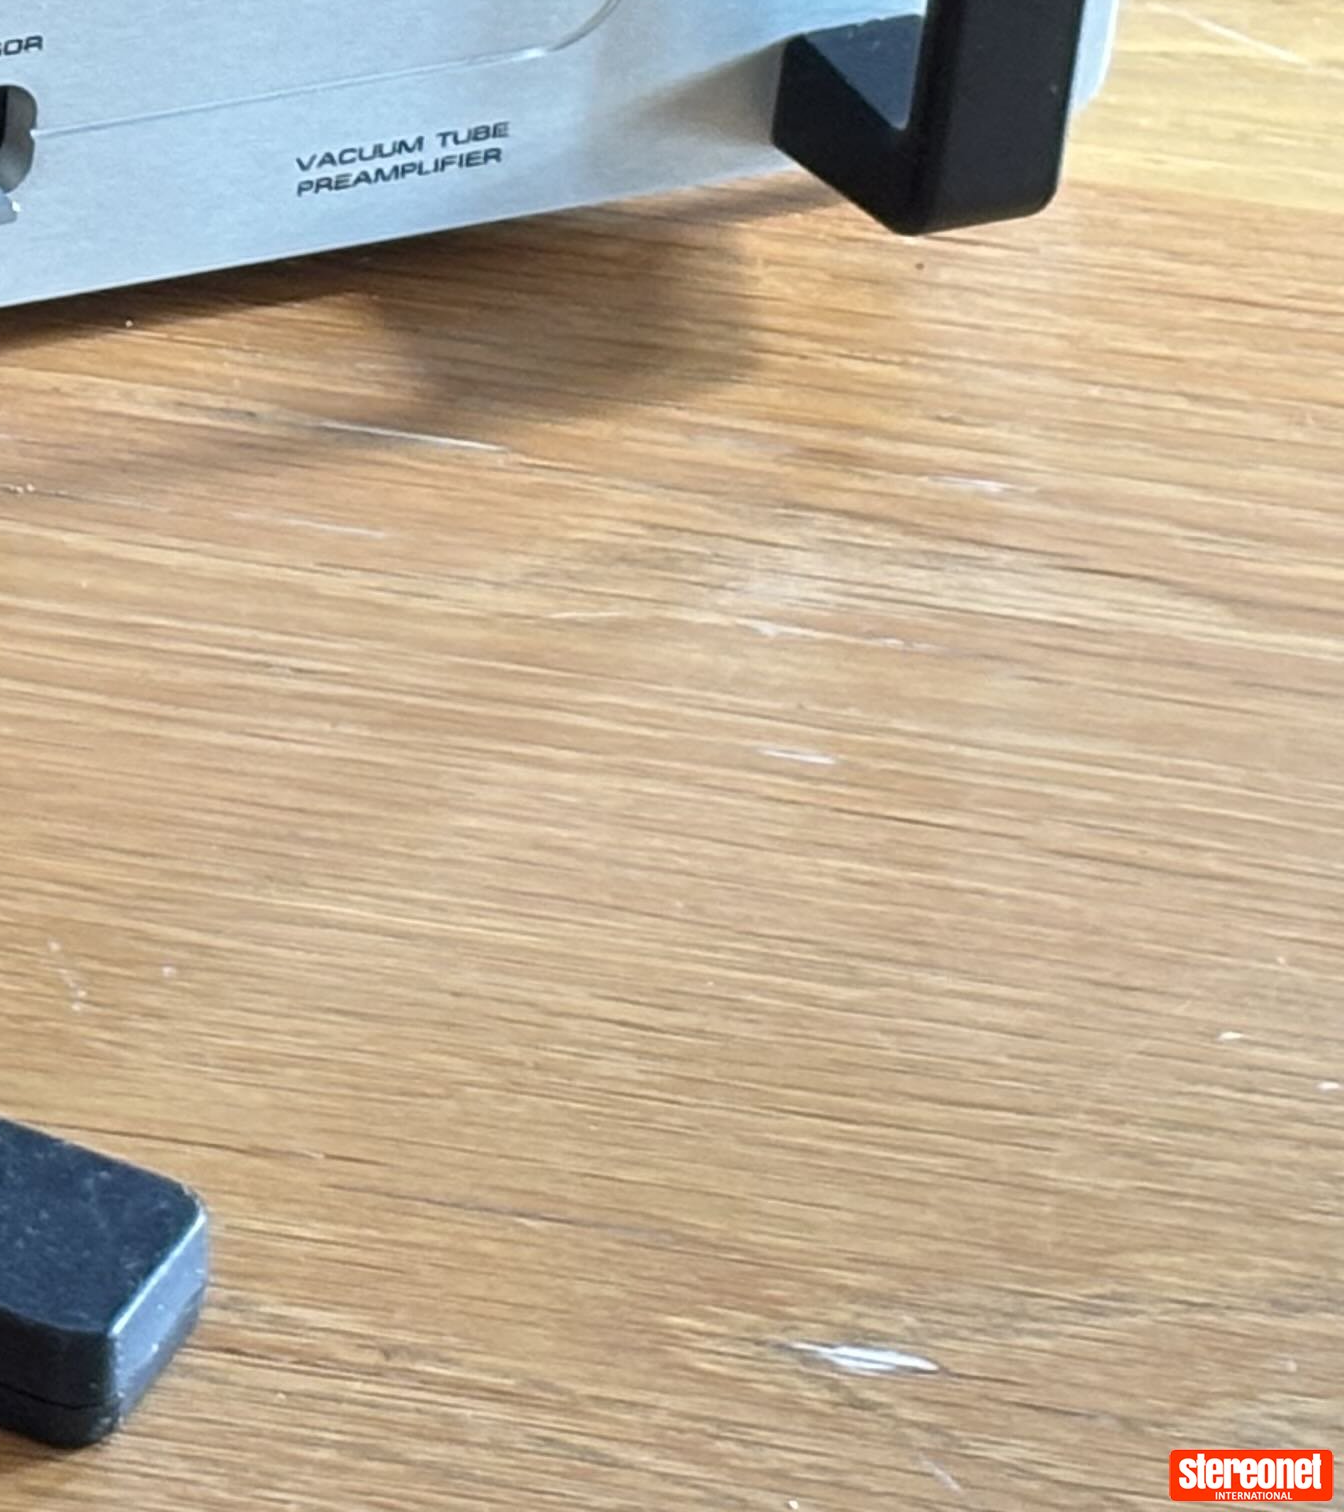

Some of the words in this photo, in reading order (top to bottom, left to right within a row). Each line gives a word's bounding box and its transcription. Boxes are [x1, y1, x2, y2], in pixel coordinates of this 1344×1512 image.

[296, 136, 424, 172] VACUUM
[435, 121, 510, 149] TUBE
[296, 147, 503, 197] PREAMPLIFIER
